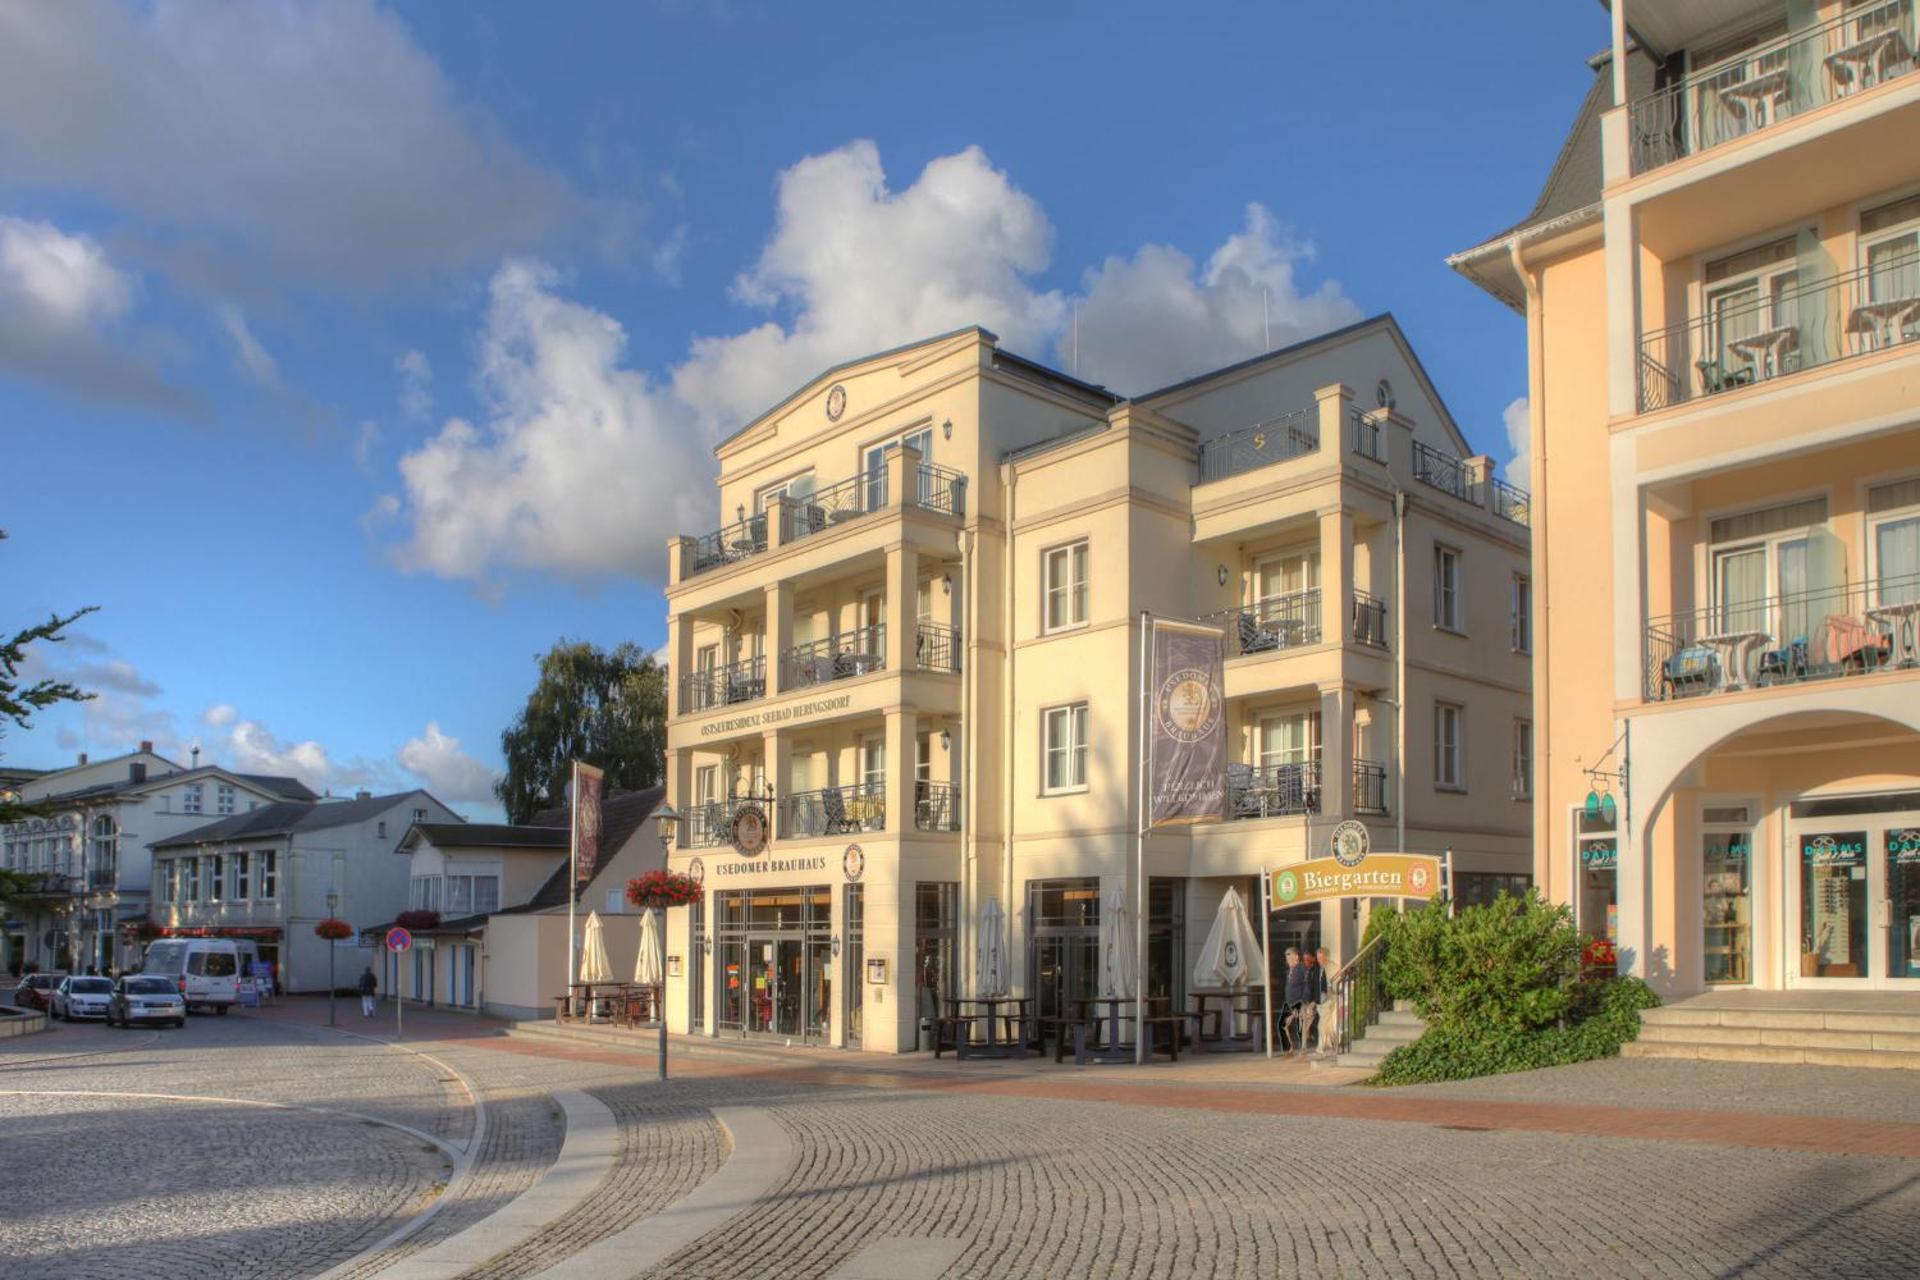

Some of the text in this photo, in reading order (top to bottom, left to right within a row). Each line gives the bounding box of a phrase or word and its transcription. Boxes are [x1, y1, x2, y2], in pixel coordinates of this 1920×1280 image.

[762, 707, 792, 724] SEEBAD
[793, 695, 850, 718] HERINGSDORF
[716, 861, 769, 876] USEDOMER
[771, 856, 826, 872] BRAUHAUS
[1303, 869, 1403, 891] Biergarten
